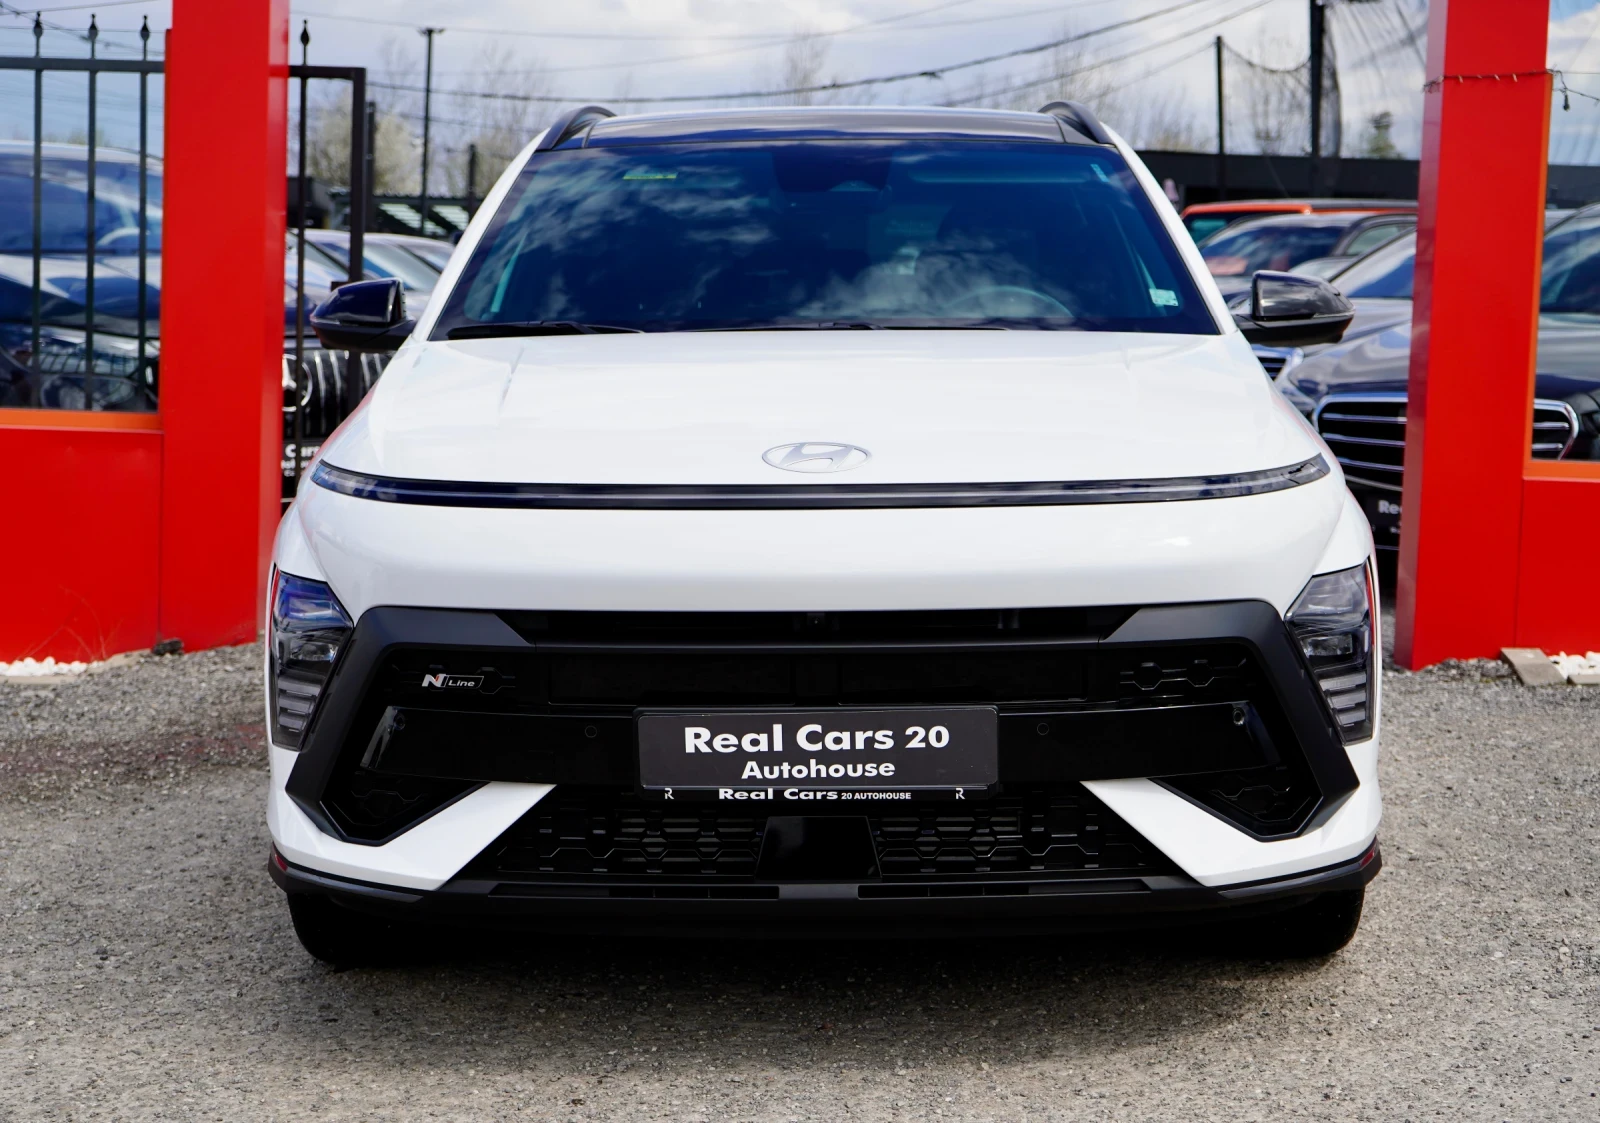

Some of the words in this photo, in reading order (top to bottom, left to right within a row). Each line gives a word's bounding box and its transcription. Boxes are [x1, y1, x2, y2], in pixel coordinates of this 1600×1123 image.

[422, 673, 446, 687] N
[684, 723, 783, 753] Real
[797, 723, 895, 751] Cars
[905, 725, 950, 749] 20
[741, 758, 896, 780] Autohouse
[718, 788, 774, 800] Real
[783, 788, 839, 800] Cars
[841, 792, 853, 800] 20
[854, 792, 912, 800] AUTOHOUSE
